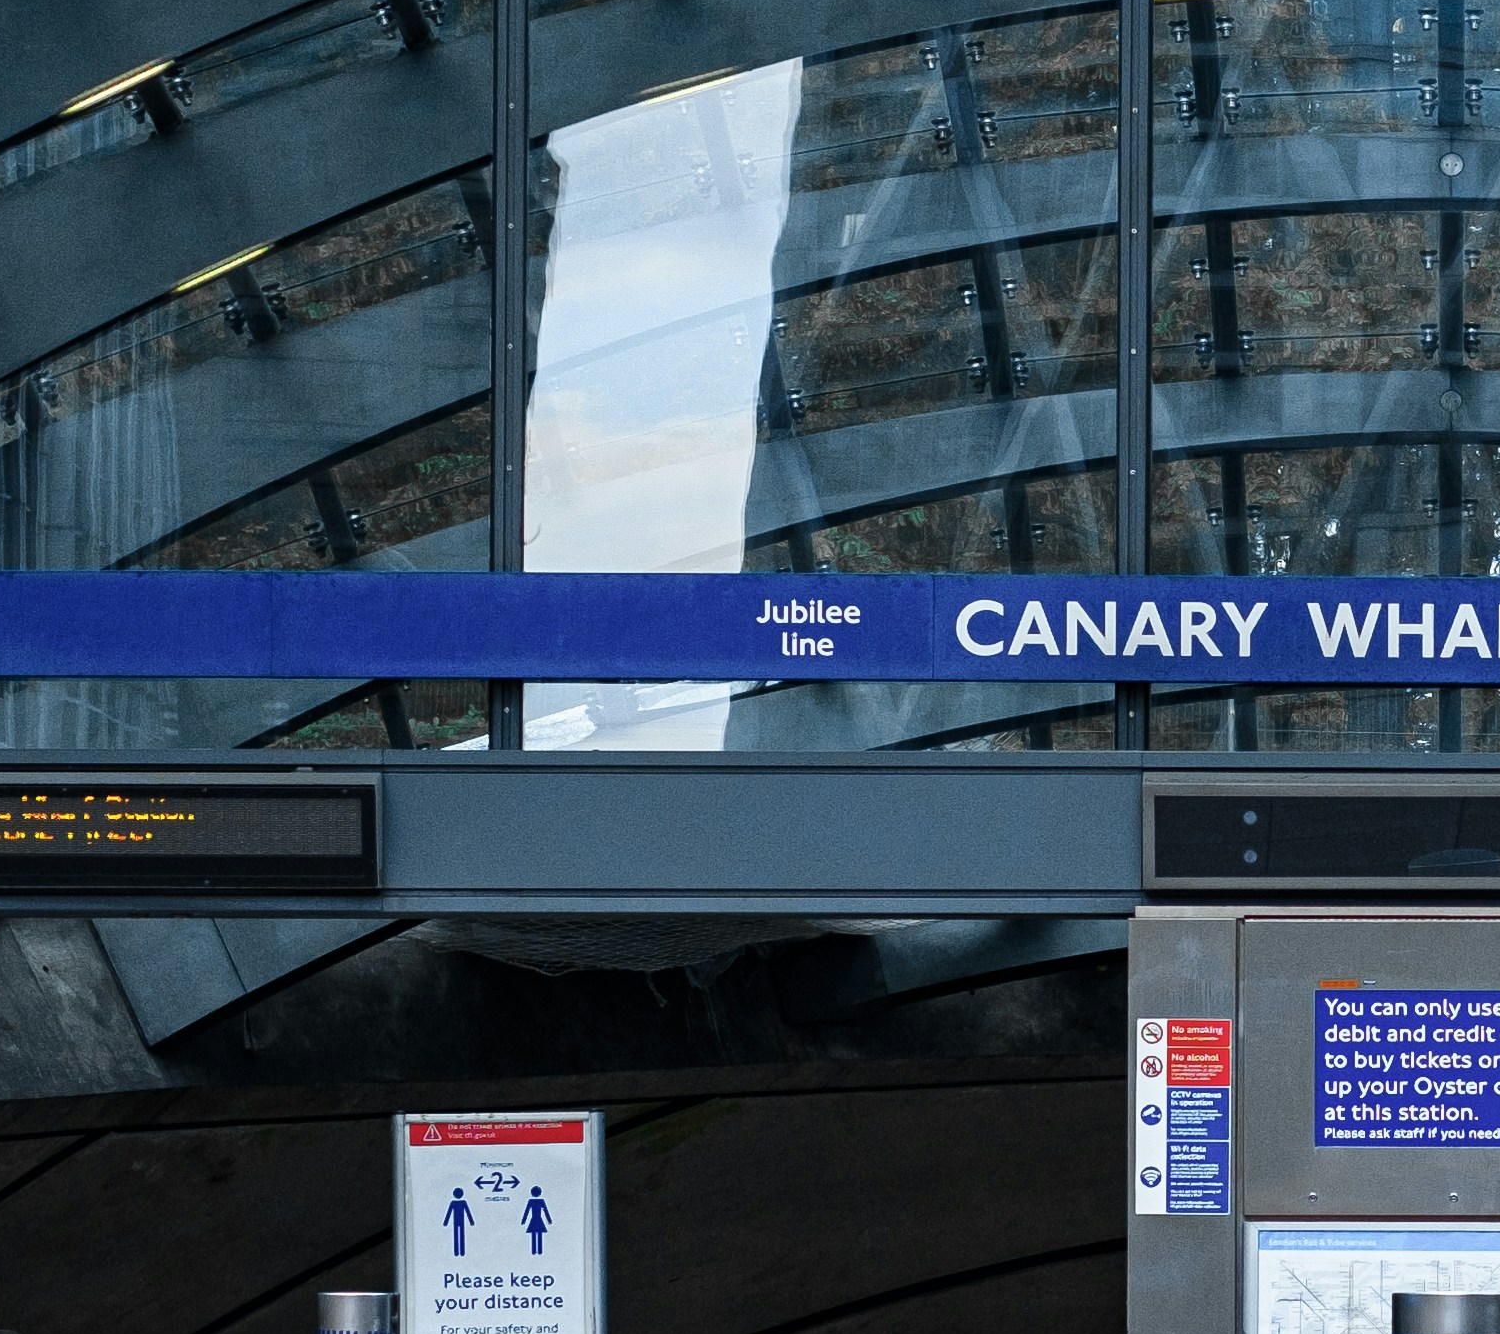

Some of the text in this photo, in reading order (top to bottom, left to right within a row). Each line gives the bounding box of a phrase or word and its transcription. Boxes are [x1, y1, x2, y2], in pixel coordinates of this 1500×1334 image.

[756, 599, 861, 624] Jubilee
[955, 599, 1269, 657] CANARY
[781, 632, 834, 656] line
[1325, 998, 1364, 1016] You
[1370, 1001, 1408, 1016] can
[1414, 998, 1461, 1020] only
[1171, 1026, 1223, 1035] No smoking
[1324, 1024, 1381, 1043] debit
[1387, 1024, 1426, 1043] and
[1432, 1024, 1496, 1043] credit
[1171, 1053, 1220, 1061] No alcohol
[1324, 1053, 1348, 1069] to
[1354, 1051, 1394, 1072] buy
[1400, 1051, 1472, 1069] tickets
[1324, 1079, 1352, 1098] up
[1358, 1079, 1408, 1098] your
[1414, 1077, 1488, 1098] Oyster
[1324, 1103, 1480, 1121] at this station.
[1324, 1127, 1366, 1139] Please
[1369, 1127, 1391, 1139] ask
[1394, 1127, 1425, 1139] staff
[1428, 1127, 1438, 1139] if
[1440, 1130, 1465, 1141] you
[1469, 1128, 1500, 1139] need
[490, 1171, 504, 1193] 2
[444, 1272, 555, 1291] Please keep
[435, 1294, 564, 1313] your distance
[441, 1324, 460, 1334] For
[535, 1323, 559, 1334] and
